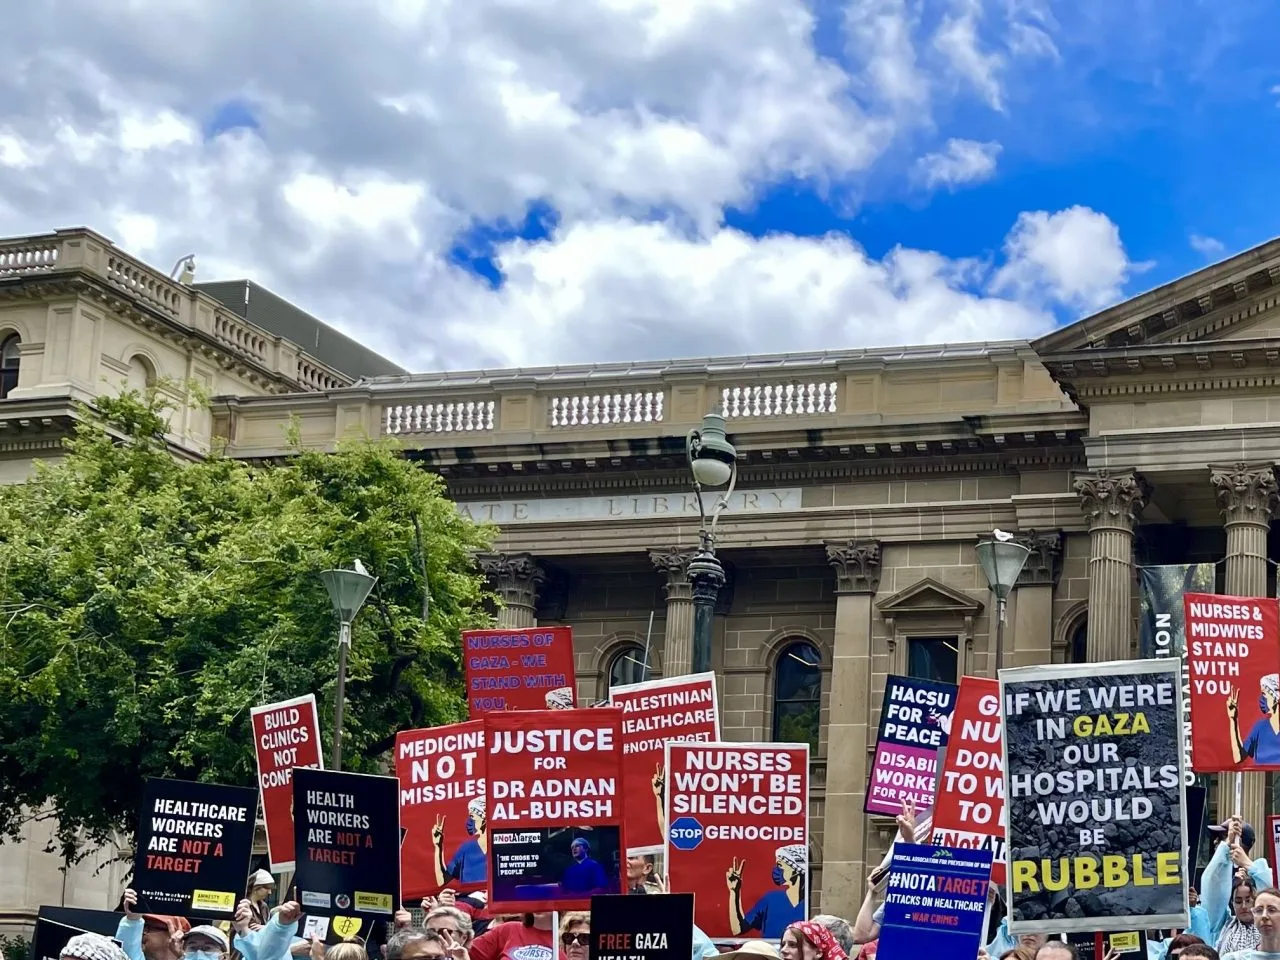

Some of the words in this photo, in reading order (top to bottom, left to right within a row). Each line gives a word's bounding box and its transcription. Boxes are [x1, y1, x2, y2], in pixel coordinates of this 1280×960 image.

[1190, 603, 1250, 620] NURSES
[1252, 607, 1263, 621] &
[468, 635, 530, 649] NURSES
[533, 633, 554, 647] OF
[1192, 623, 1264, 639] MIDWIVES
[1192, 642, 1249, 657] STAND
[470, 656, 510, 670] GAZA
[521, 654, 547, 667] WE
[1193, 661, 1239, 676] WITH
[471, 676, 520, 690] STAND
[522, 674, 566, 688] WITH
[1194, 680, 1231, 694] YOU
[474, 697, 505, 711] YOU
[890, 685, 950, 708] HACSU
[1005, 695, 1031, 716] IF
[1036, 688, 1081, 712] WE
[1084, 683, 1172, 709] WERE
[264, 708, 300, 731] BUILD
[887, 704, 922, 723] FOR
[884, 723, 941, 745] PEACE
[1037, 718, 1065, 740] IN
[1073, 712, 1150, 737] GAZA
[261, 725, 309, 750] CLINICS
[400, 731, 485, 760] MEDICINE
[490, 728, 614, 754] JUSTICE
[273, 748, 298, 768] NOT
[534, 757, 566, 770] FOR
[686, 751, 792, 772] NURSES
[1063, 742, 1119, 765] OUR
[411, 752, 477, 784] NOT
[401, 777, 486, 806] MISSILES
[493, 781, 524, 799] DR
[530, 778, 615, 798] ADNAN
[770, 774, 802, 794] BE
[1012, 765, 1179, 797] HOSPITALS
[154, 798, 247, 822] HEALTHCARE
[492, 800, 612, 821] AL-BURSH
[673, 795, 802, 816] SILENCED
[1038, 797, 1153, 825] WOULD
[151, 817, 223, 839] WORKERS
[670, 828, 702, 839] STOP
[705, 825, 804, 841] GENOCIDE
[1080, 829, 1105, 846] BE
[148, 837, 178, 852] ARE
[182, 839, 213, 856] NOT
[214, 841, 223, 857] A
[147, 854, 202, 874] TARGET
[1012, 852, 1180, 894] RUBBLE
[886, 894, 920, 905] ATTACKS
[922, 897, 933, 906] ON
[934, 899, 984, 912] HEALTHCARE
[599, 934, 631, 950] FREE
[635, 933, 668, 949] GAZA
